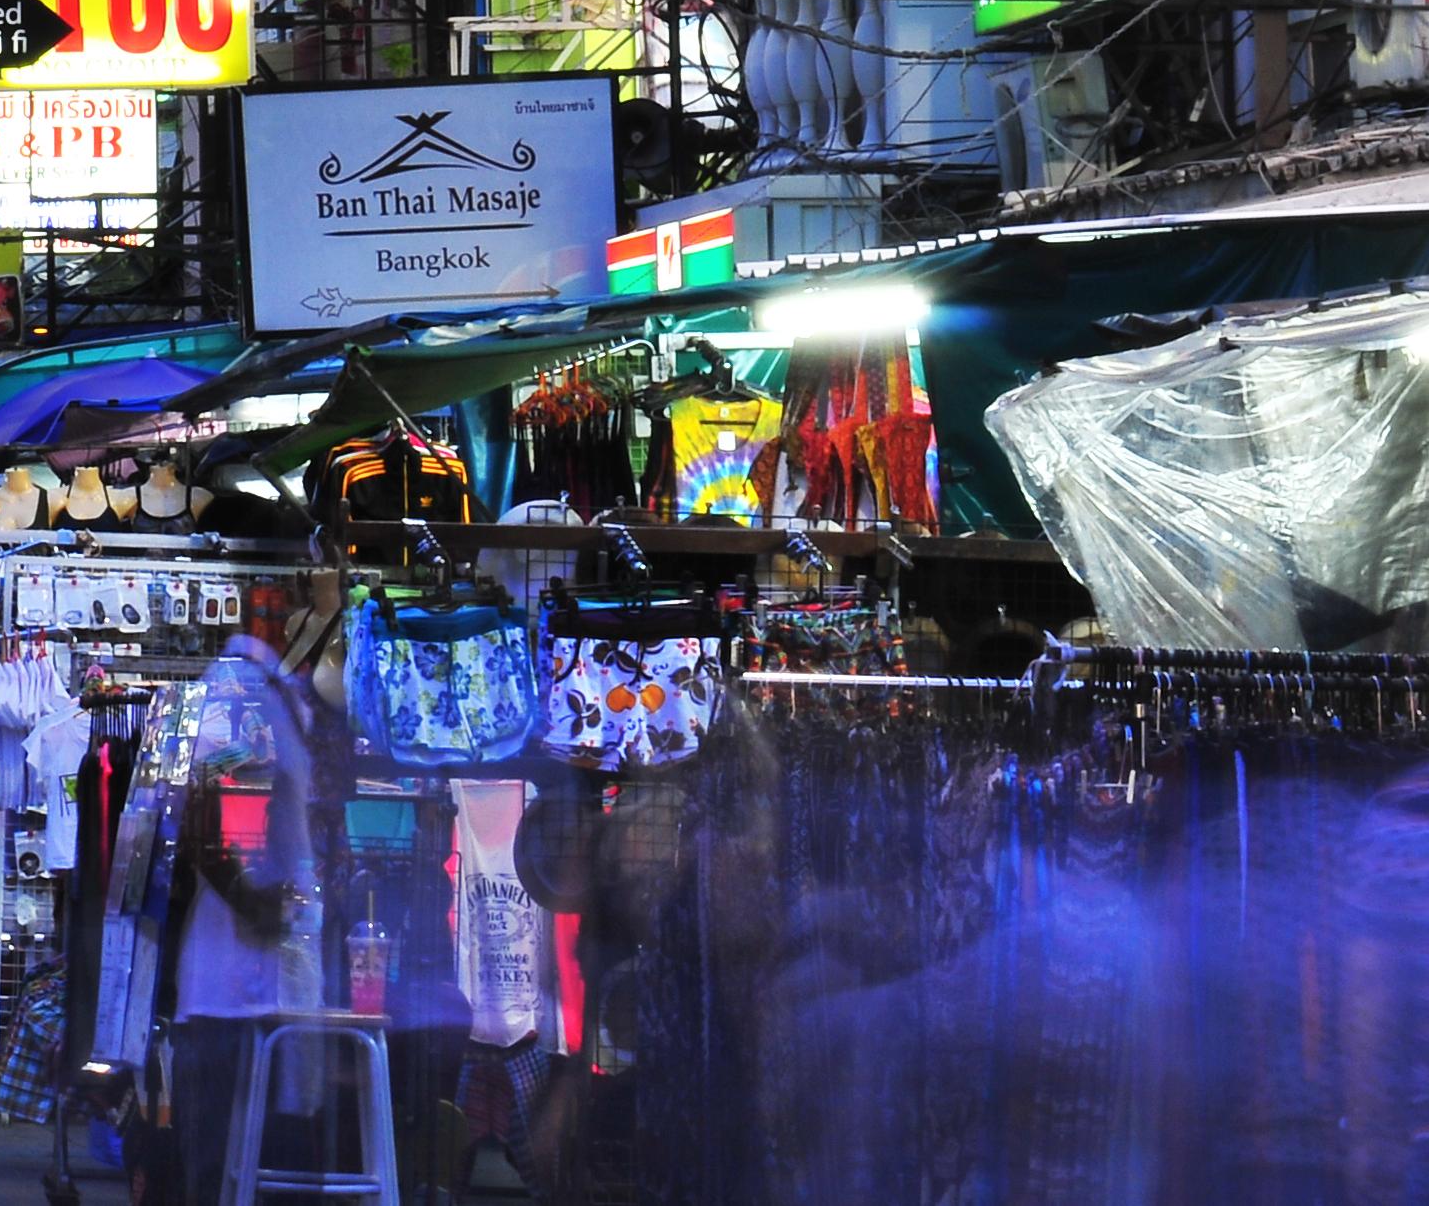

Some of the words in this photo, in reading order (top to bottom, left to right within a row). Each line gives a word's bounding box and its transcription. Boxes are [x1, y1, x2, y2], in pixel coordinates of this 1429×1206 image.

[316, 191, 368, 221] Ban
[372, 186, 438, 216] Thai
[447, 181, 541, 214] Masaje
[375, 246, 490, 279] Bangkok
